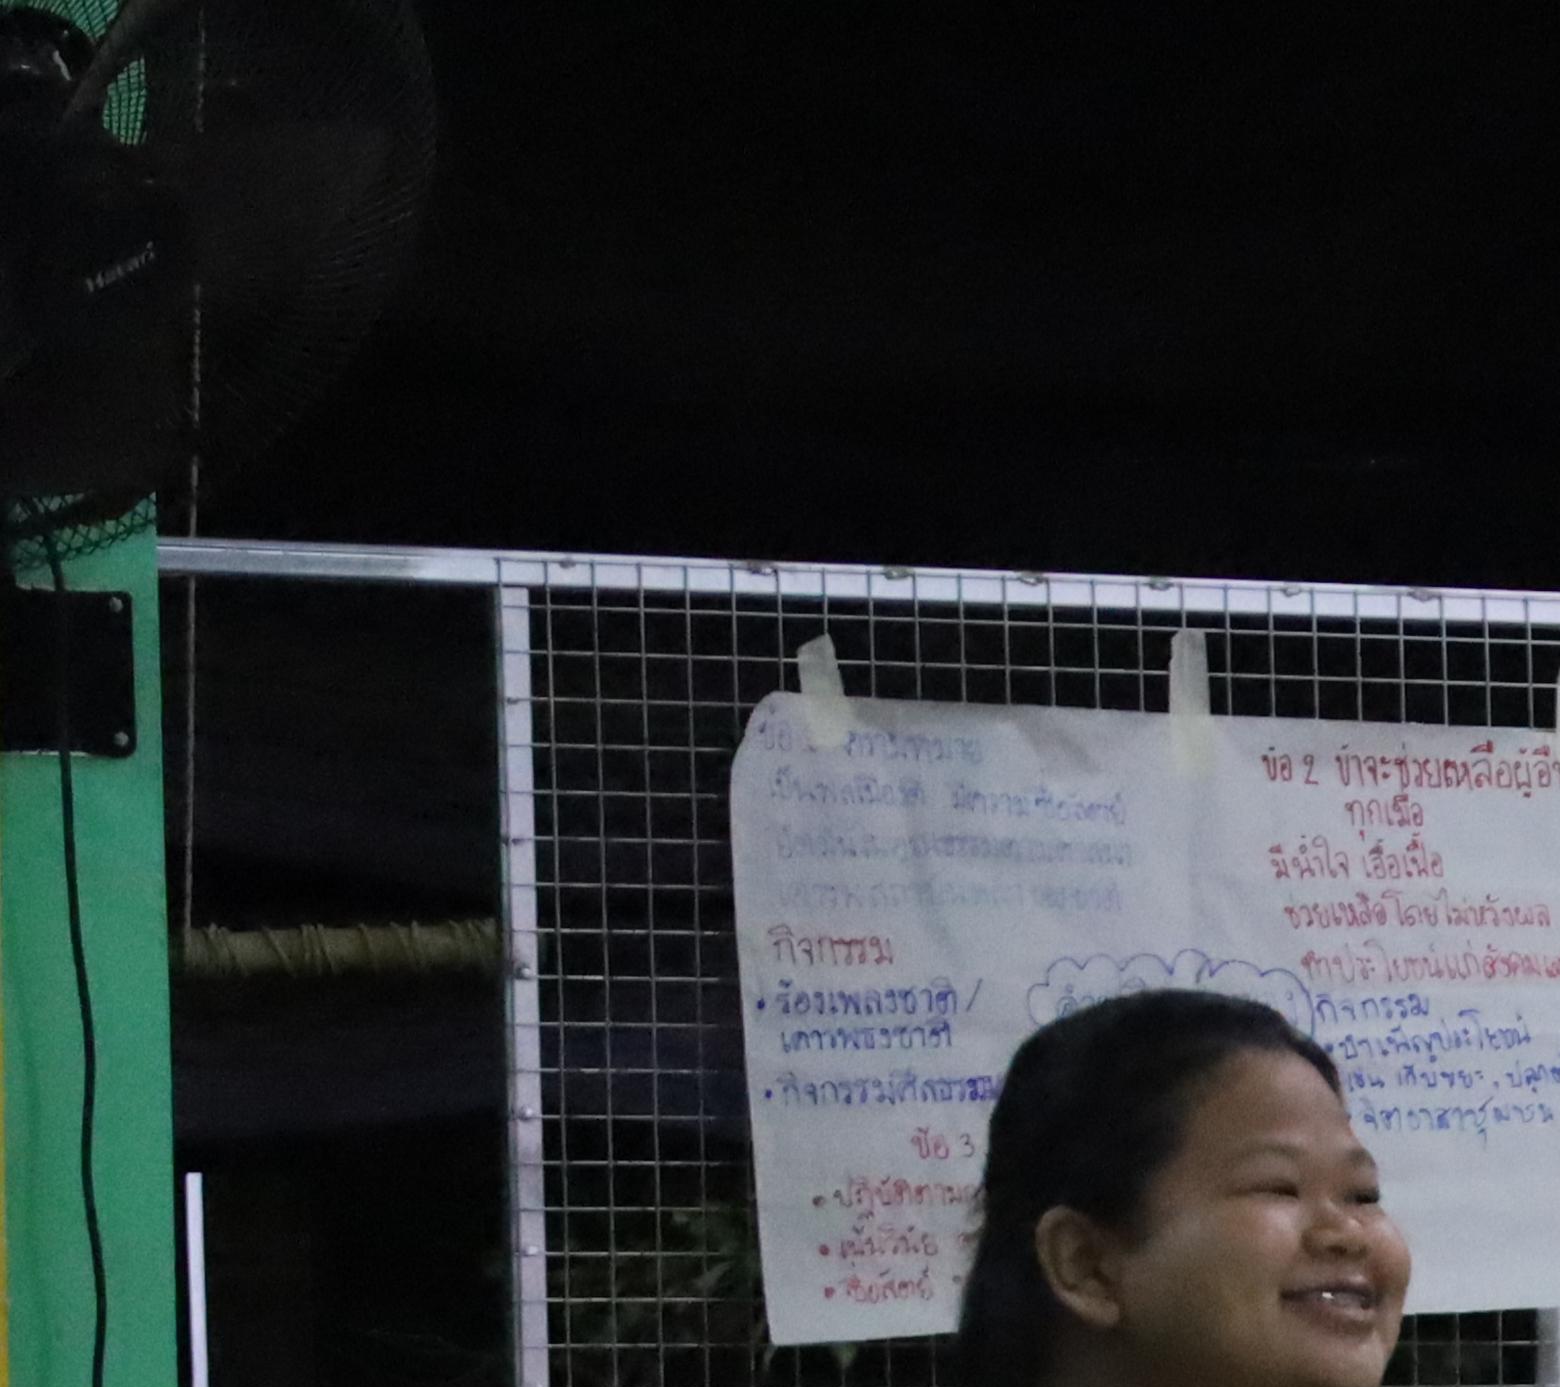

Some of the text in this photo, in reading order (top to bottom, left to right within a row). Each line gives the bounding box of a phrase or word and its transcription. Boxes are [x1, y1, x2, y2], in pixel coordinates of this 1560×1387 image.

[768, 923, 895, 966] กิจกรรม
[1315, 992, 1430, 1025] กิจกรรม
[911, 1125, 950, 1160] ข้อ
